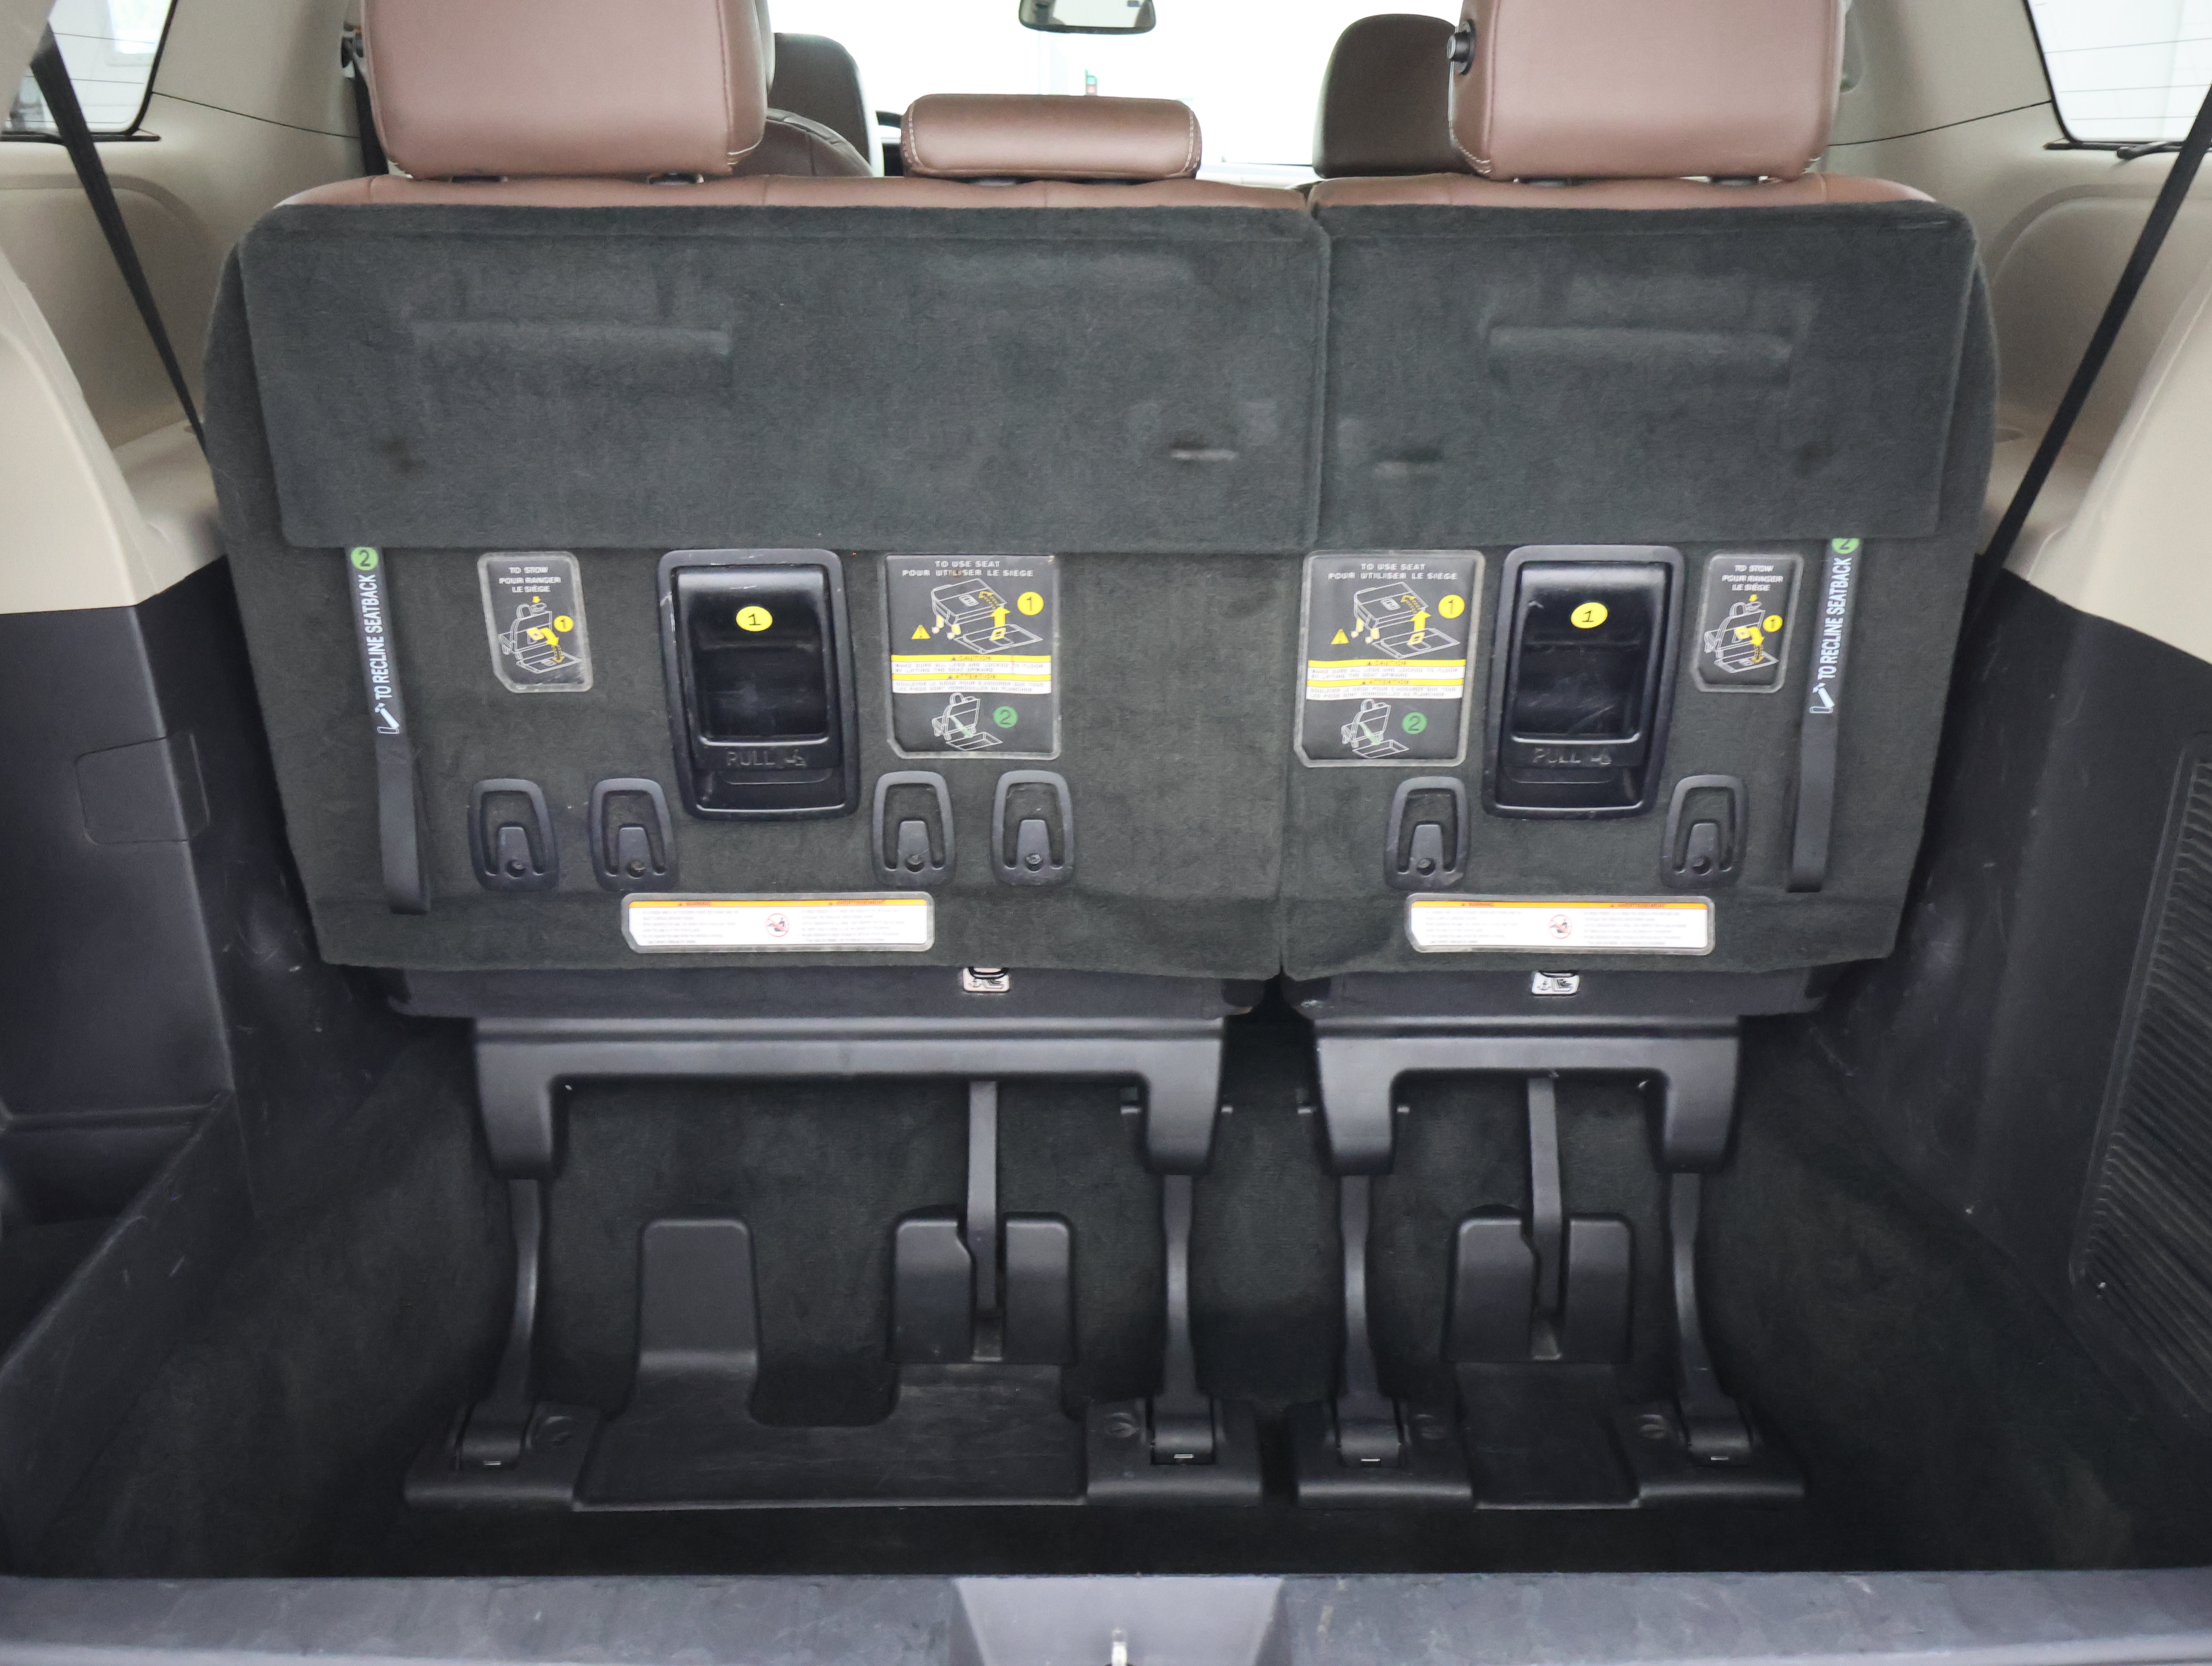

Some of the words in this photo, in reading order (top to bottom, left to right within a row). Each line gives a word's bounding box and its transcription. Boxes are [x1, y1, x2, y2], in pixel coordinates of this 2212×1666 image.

[358, 550, 371, 567] 2
[1826, 558, 1853, 615] SEATBACK
[358, 574, 383, 634] SEATBACK
[748, 614, 762, 626] 1
[1582, 610, 1594, 622] 1
[1819, 617, 1844, 664] RECLINE
[366, 636, 390, 683] RECLINE
[1817, 666, 1837, 680] TO
[374, 685, 393, 700] TO
[999, 710, 1012, 725] 2
[1408, 716, 1421, 731] 2
[726, 751, 776, 766] PULL
[1533, 748, 1581, 764] PULL
